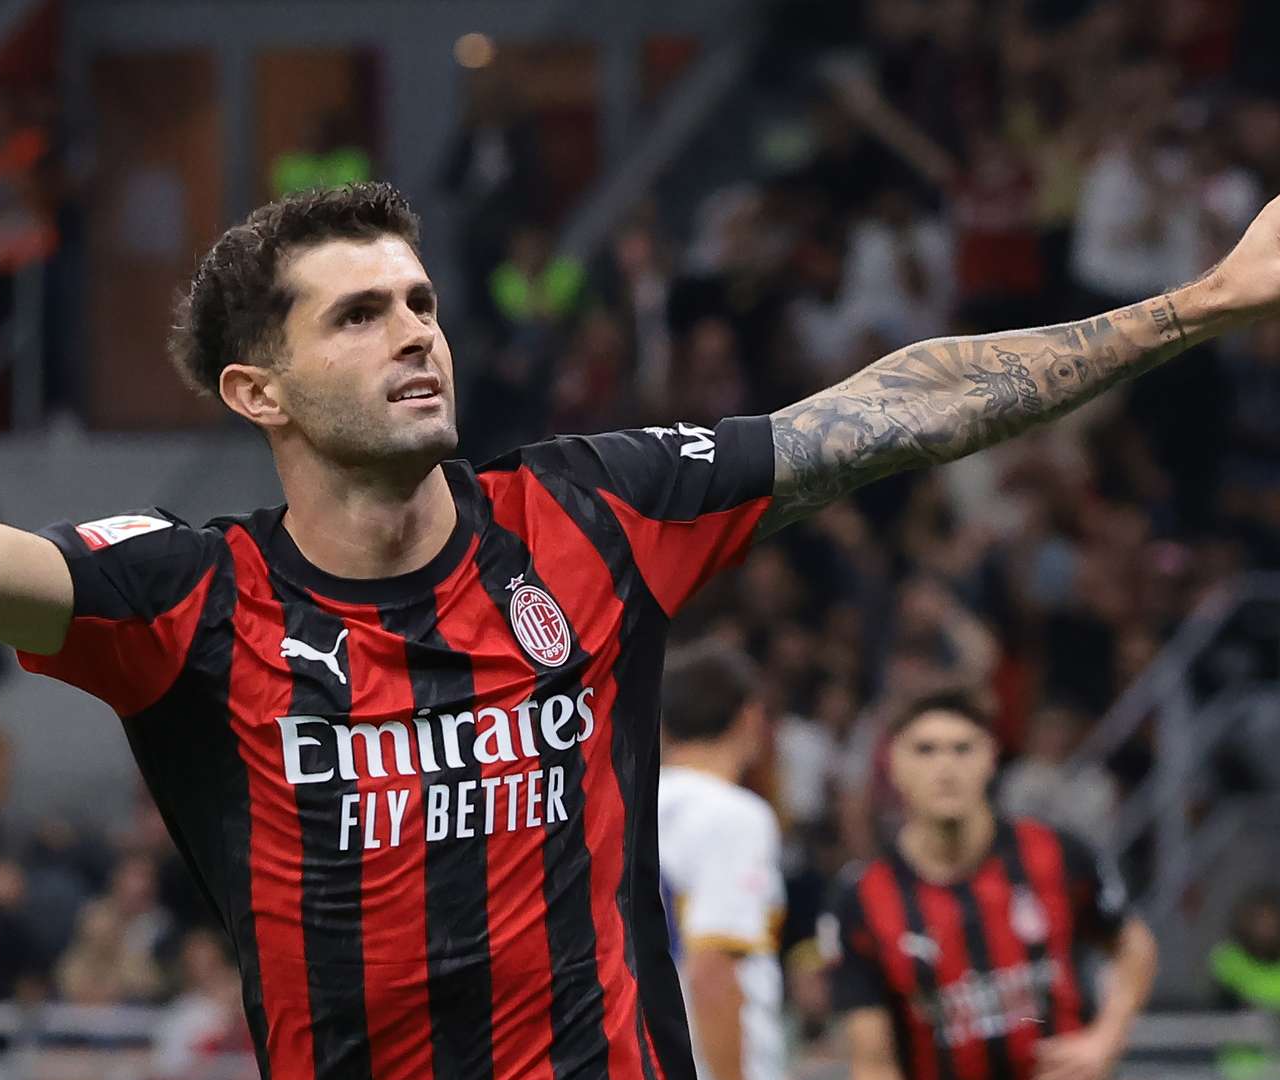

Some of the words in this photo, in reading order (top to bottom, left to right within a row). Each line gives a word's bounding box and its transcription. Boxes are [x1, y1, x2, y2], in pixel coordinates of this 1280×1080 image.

[541, 642, 564, 659] 1899
[275, 687, 594, 784] Emirates
[339, 790, 410, 850] FLY
[426, 765, 569, 842] BETTER
